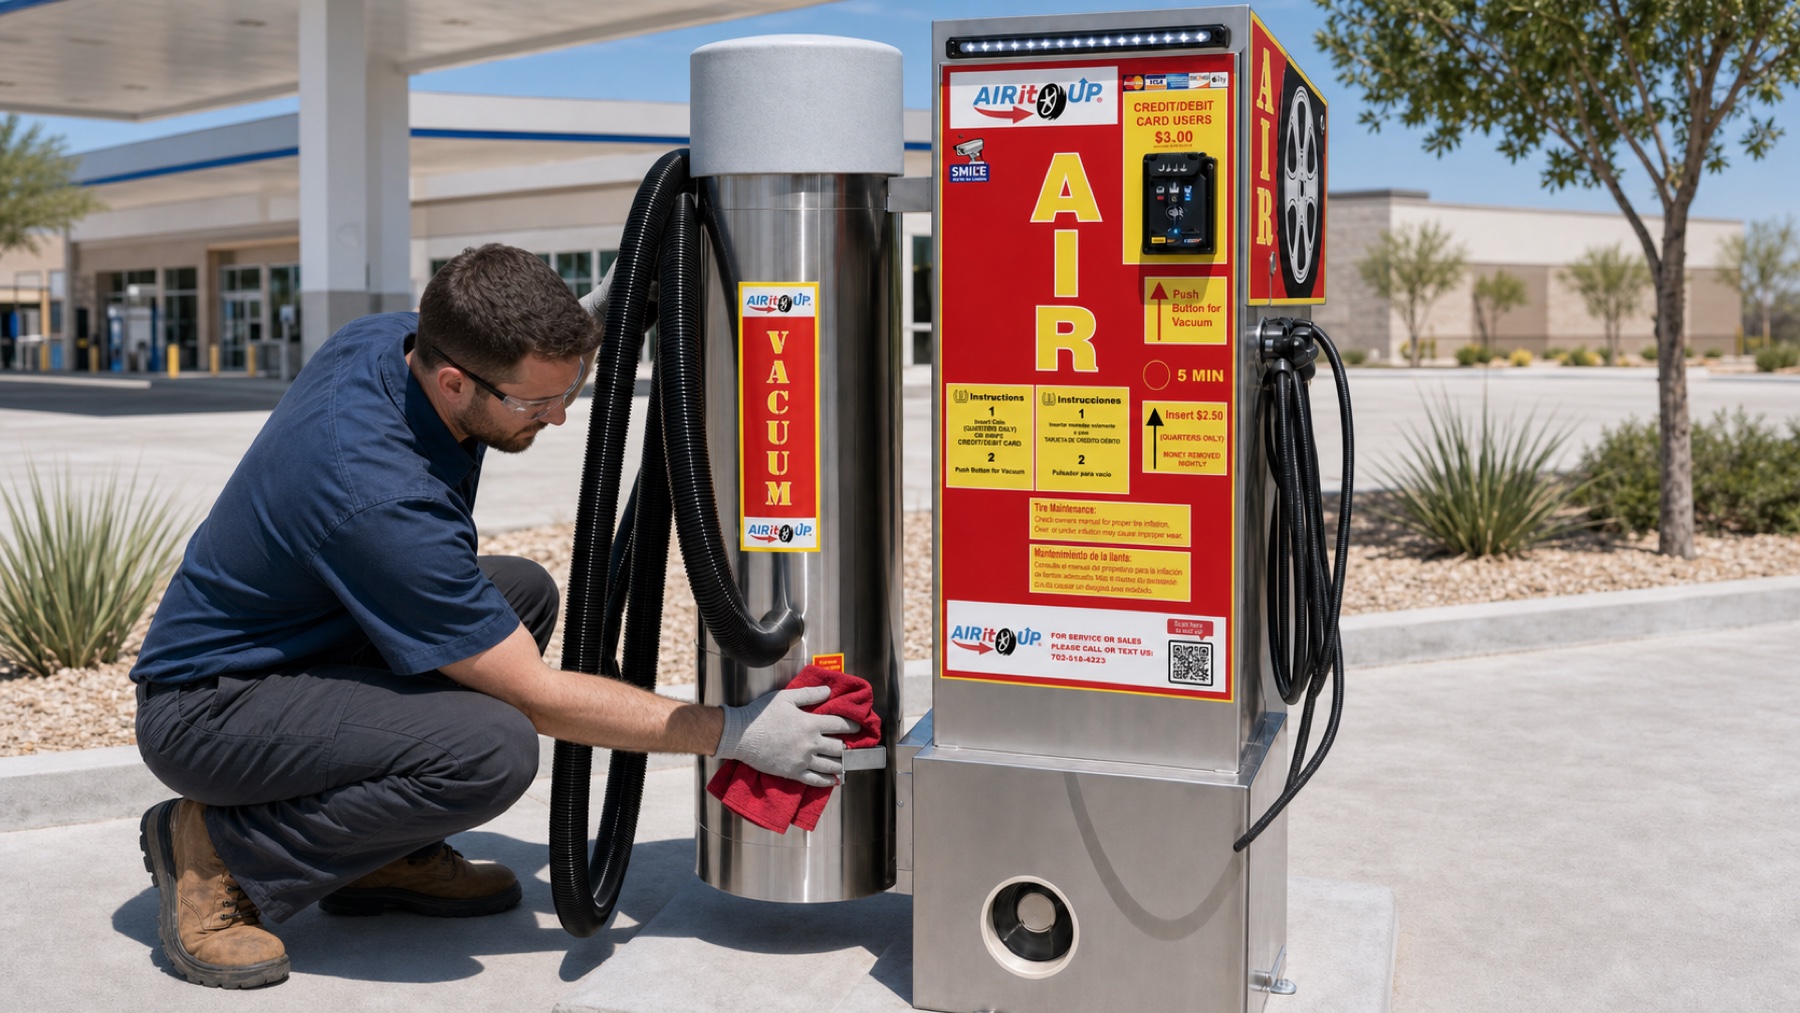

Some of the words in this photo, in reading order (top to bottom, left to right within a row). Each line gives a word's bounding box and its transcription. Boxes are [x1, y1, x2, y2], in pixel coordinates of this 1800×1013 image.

[1134, 100, 1214, 112] CREDIT/DEBIT
[1136, 116, 1169, 126] CARD
[1173, 115, 1212, 125] USERS
[1155, 130, 1193, 144] $3.00
[1256, 47, 1274, 246] AIR
[952, 166, 987, 177] SMILE
[1030, 152, 1103, 372] AIR
[1173, 289, 1198, 299] Push
[1172, 304, 1204, 312] Button
[1207, 304, 1221, 312] for
[1172, 317, 1212, 327] Vacuum
[1178, 369, 1186, 382] 5
[1192, 369, 1224, 382] MIN
[970, 393, 1024, 401] Instructions
[1058, 396, 1121, 404] Instrucciones
[989, 406, 994, 416] 1
[1079, 408, 1084, 419] 1
[1166, 410, 1194, 420] Insert
[1197, 410, 1223, 420] $2.50
[765, 330, 792, 506] VACUUM
[1203, 435, 1224, 443] ONLY)
[988, 453, 995, 462] 2
[1078, 455, 1085, 464] 2
[1069, 634, 1102, 642] SERVICE
